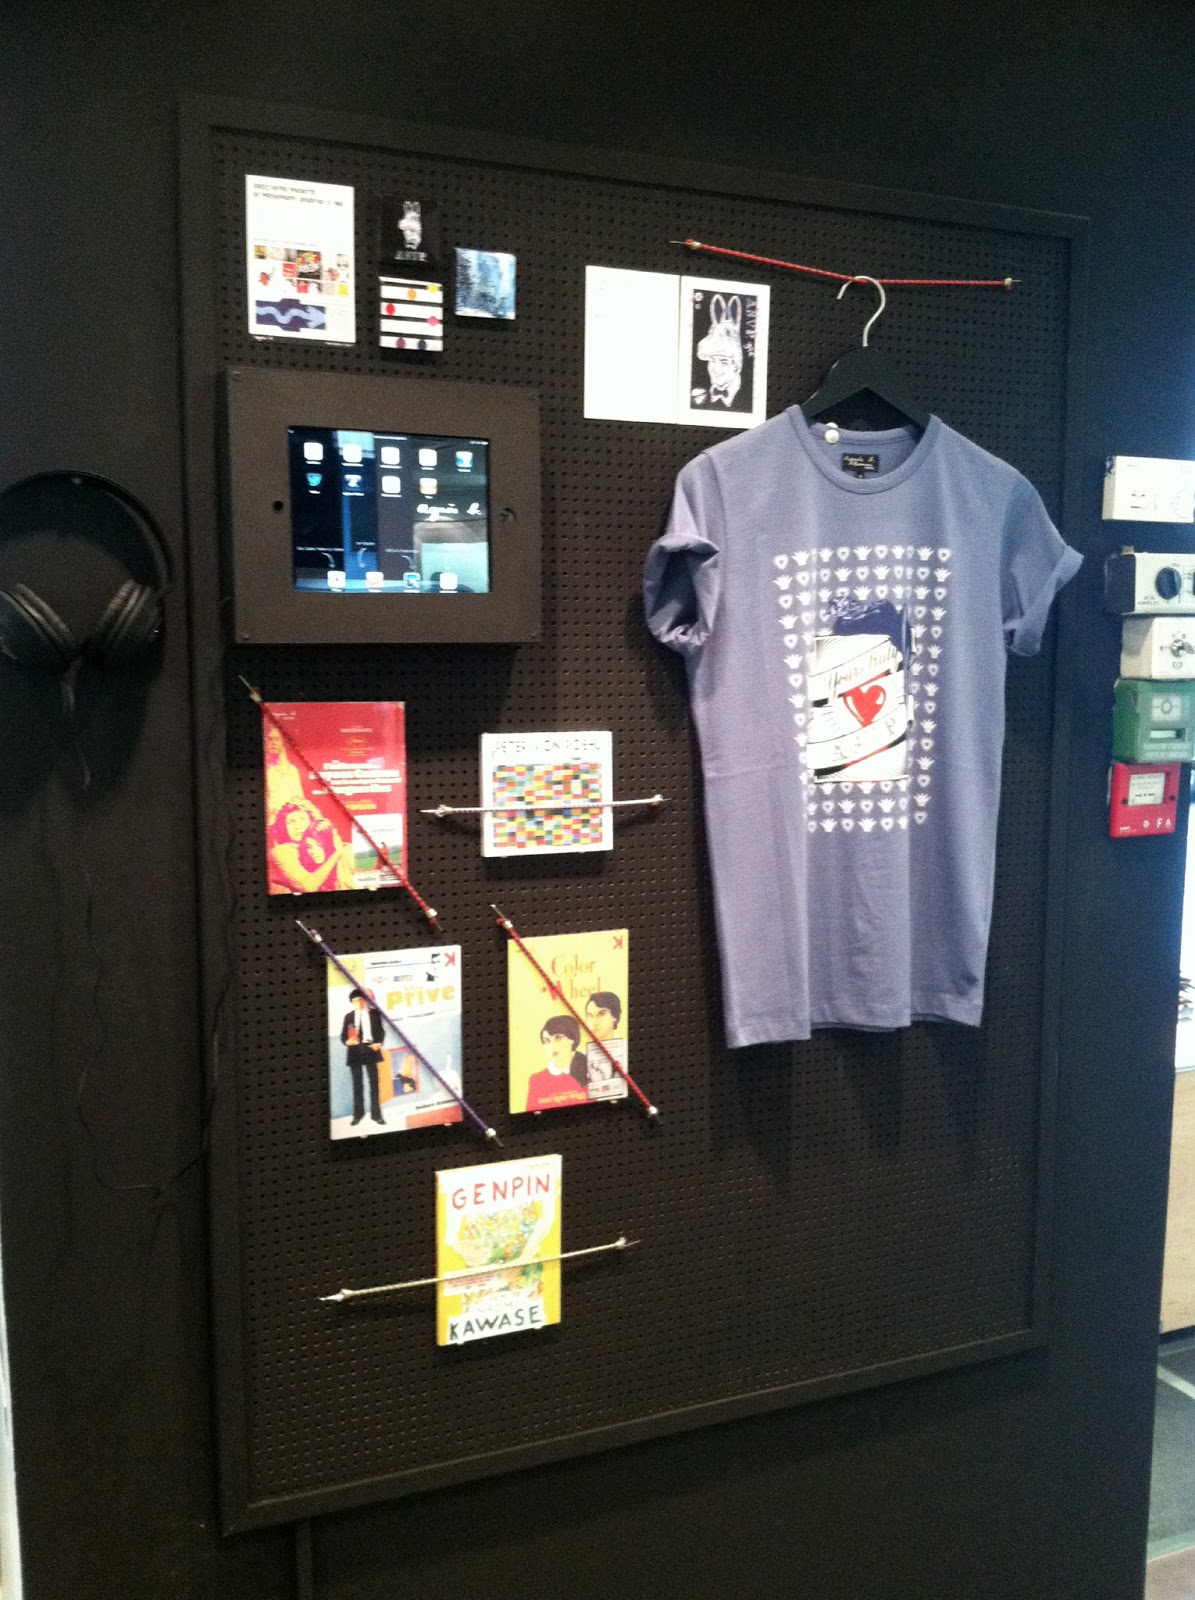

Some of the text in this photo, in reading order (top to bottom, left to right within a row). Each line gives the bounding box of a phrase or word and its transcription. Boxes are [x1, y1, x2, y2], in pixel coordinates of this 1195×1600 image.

[551, 953, 596, 977] Color
[452, 1174, 550, 1210] GENPIN
[450, 1305, 542, 1341] KAWASE
